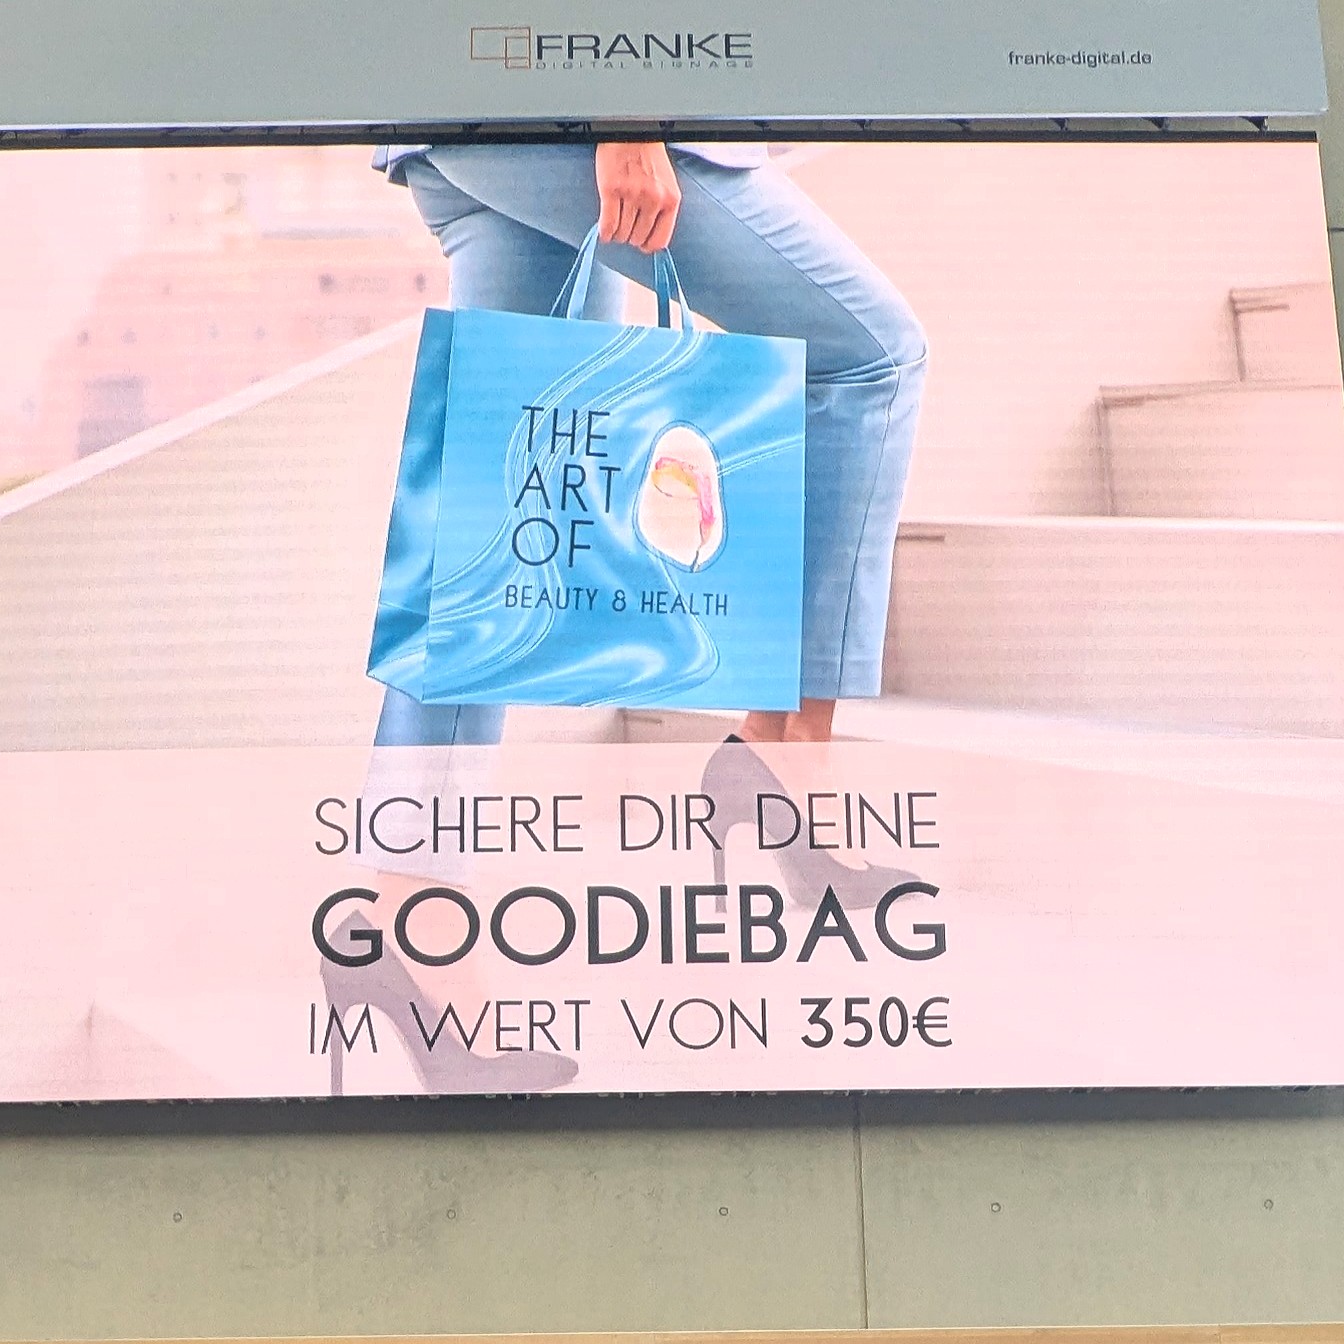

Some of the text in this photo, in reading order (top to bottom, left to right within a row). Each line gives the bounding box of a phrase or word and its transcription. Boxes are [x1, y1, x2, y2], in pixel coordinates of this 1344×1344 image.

[535, 60, 754, 70] DIGITAL SIGNAGE
[536, 33, 753, 60] FRANKE
[1008, 50, 1152, 68] franke-digital.de
[521, 405, 611, 458] THE
[514, 463, 622, 514] ART
[511, 516, 595, 568] OF
[505, 584, 598, 612] BEAUTY
[641, 590, 728, 616] HEALTH
[315, 792, 941, 856] SICHERE DIR DEINE
[311, 882, 948, 968] GOODIEBAG
[309, 995, 952, 1055] IM WERT VON 350€
